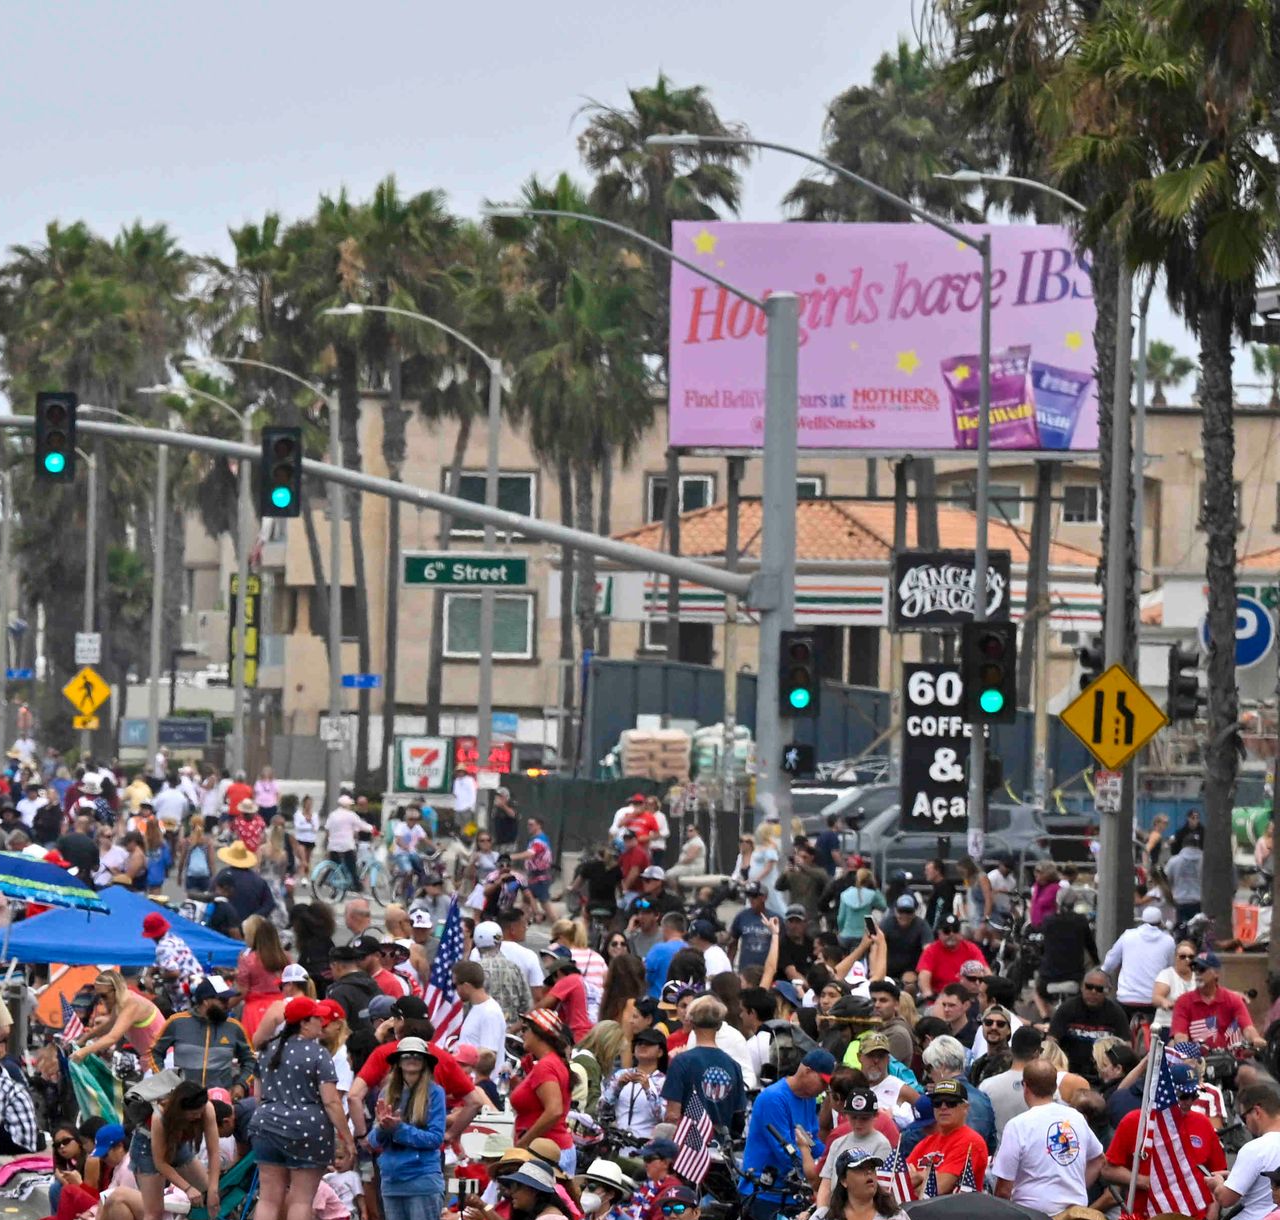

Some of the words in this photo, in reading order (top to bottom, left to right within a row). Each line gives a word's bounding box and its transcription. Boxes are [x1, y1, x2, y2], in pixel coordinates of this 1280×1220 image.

[889, 262, 1007, 320] have
[423, 561, 445, 580] 6th
[452, 563, 508, 581] Street
[929, 747, 965, 782] &
[911, 791, 971, 824] Aça
